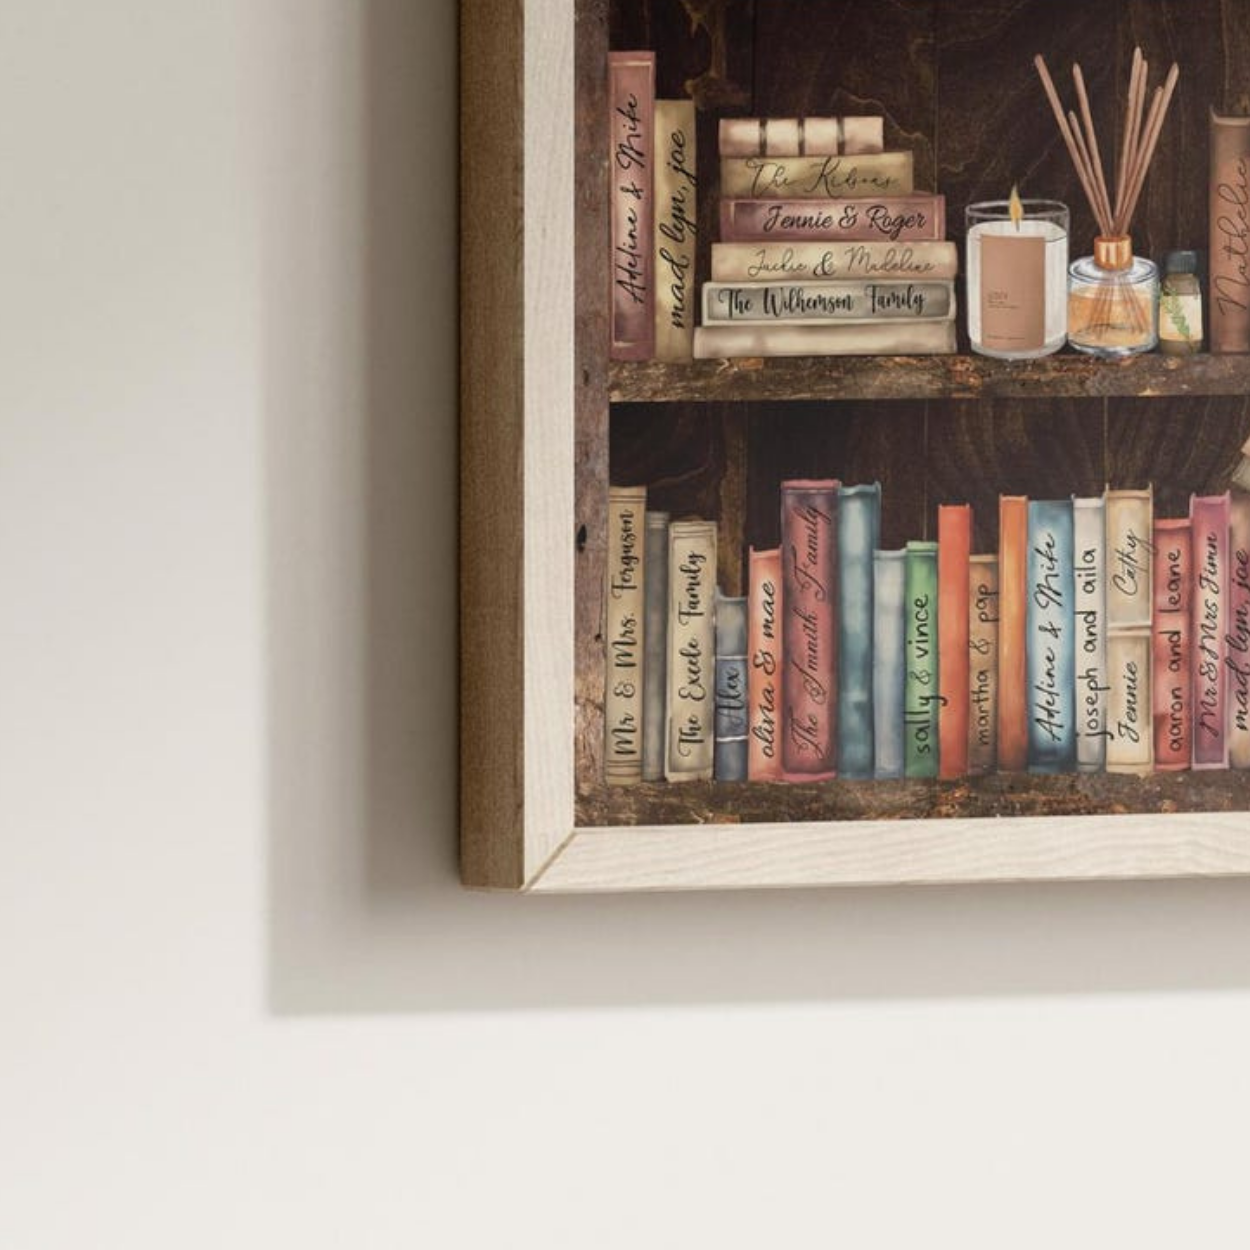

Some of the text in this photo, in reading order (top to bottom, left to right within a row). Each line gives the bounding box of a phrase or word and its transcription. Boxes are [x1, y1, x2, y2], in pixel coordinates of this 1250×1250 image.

[667, 129, 698, 187] joe
[616, 94, 646, 303] Adeline & Mike
[763, 205, 926, 241] Jennie & Roger
[718, 288, 753, 319] The
[864, 284, 926, 315] Family
[611, 509, 639, 599] Ferguson
[678, 550, 707, 626] Family
[792, 506, 831, 600] Family
[1112, 529, 1157, 596] Cathy
[752, 580, 776, 758] olivia & mae
[905, 594, 948, 754] sally & vince
[1034, 532, 1061, 741] Adeline & Mike
[1074, 549, 1115, 740] joseph and aila
[1160, 550, 1182, 751] aaron and leane
[614, 681, 636, 698] &
[718, 667, 745, 724] Alex
[1118, 661, 1139, 743] Jennie
[611, 712, 637, 756] Mr
[678, 716, 704, 757] The
[790, 706, 823, 758] The
